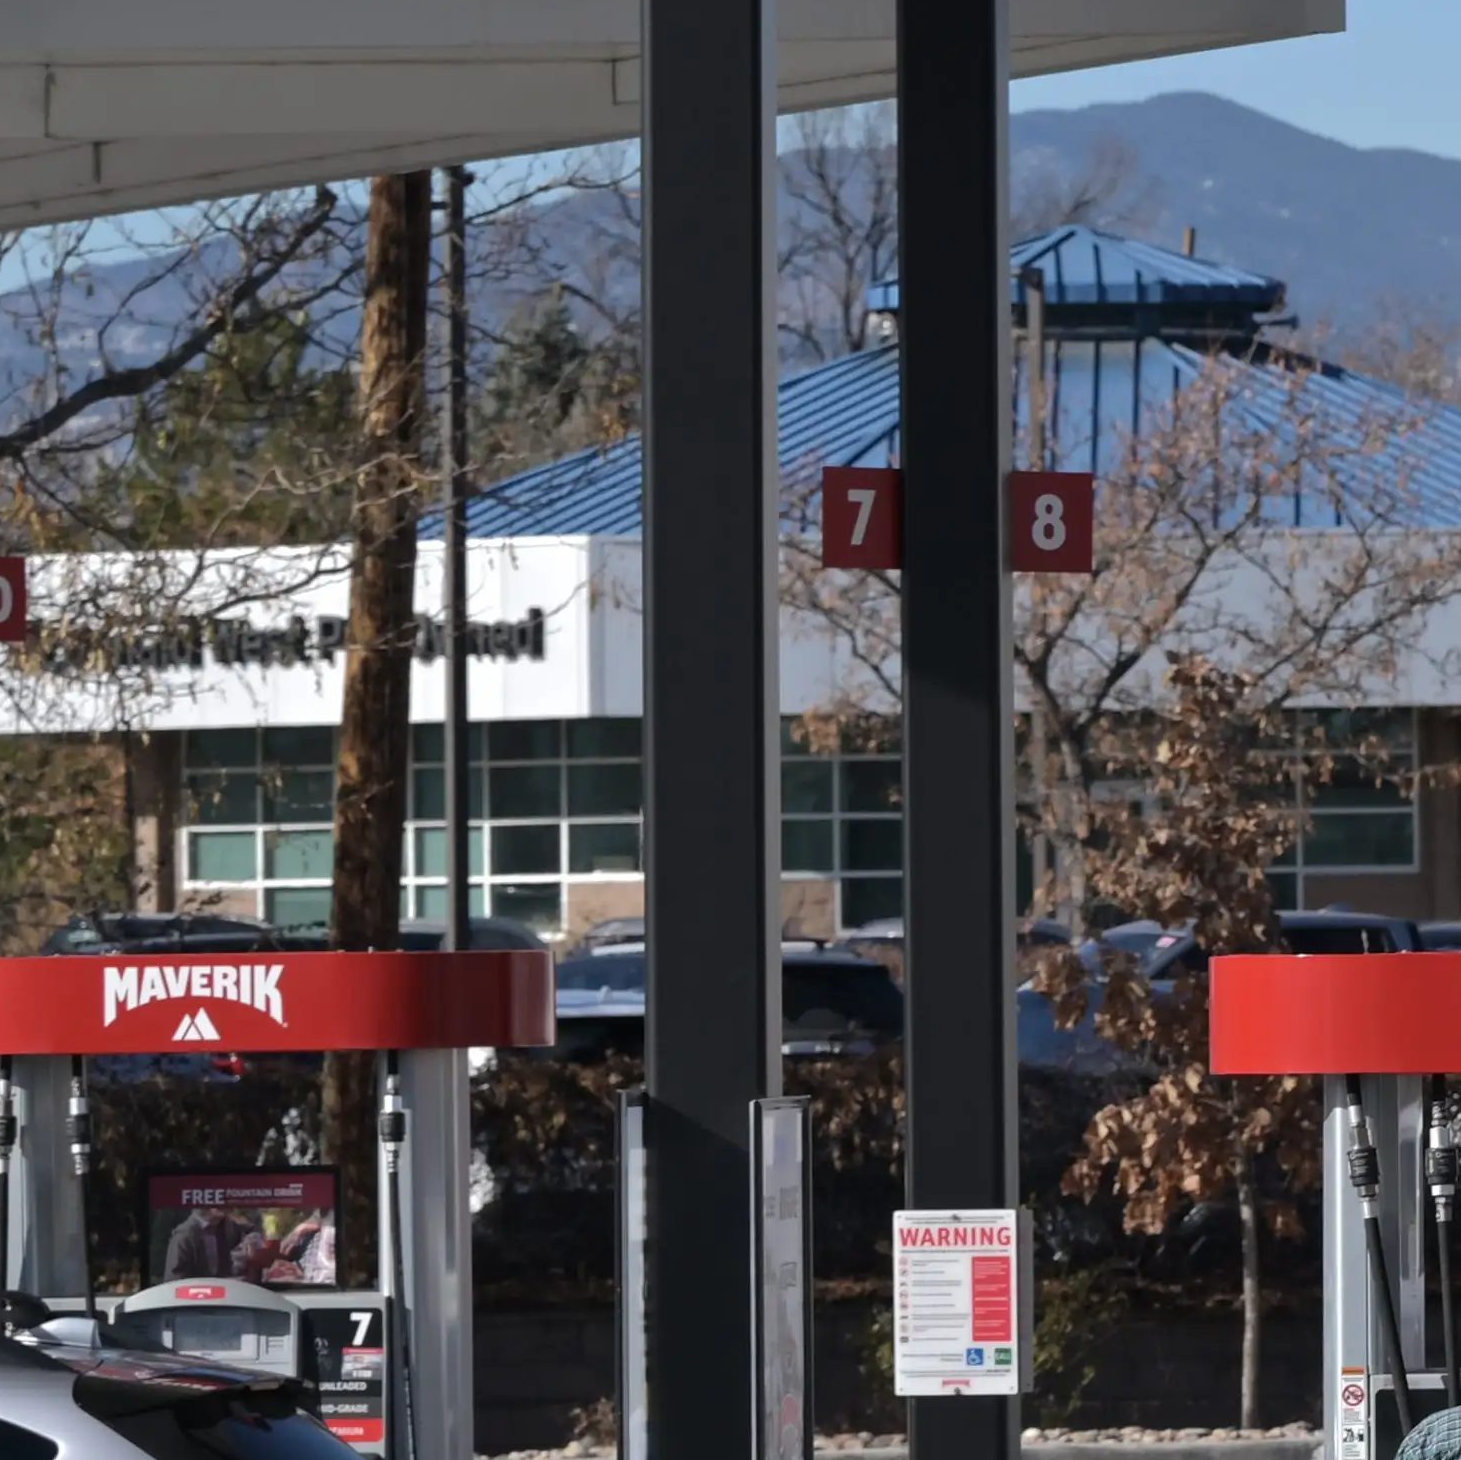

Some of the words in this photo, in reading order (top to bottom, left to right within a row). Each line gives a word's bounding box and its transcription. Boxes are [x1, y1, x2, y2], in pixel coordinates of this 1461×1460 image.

[848, 489, 876, 545] 7
[1031, 493, 1067, 551] 8
[103, 965, 284, 1027] MAVERIK
[182, 1189, 225, 1204] FREE
[899, 1227, 1012, 1246] WARNING
[350, 1311, 373, 1347] 7
